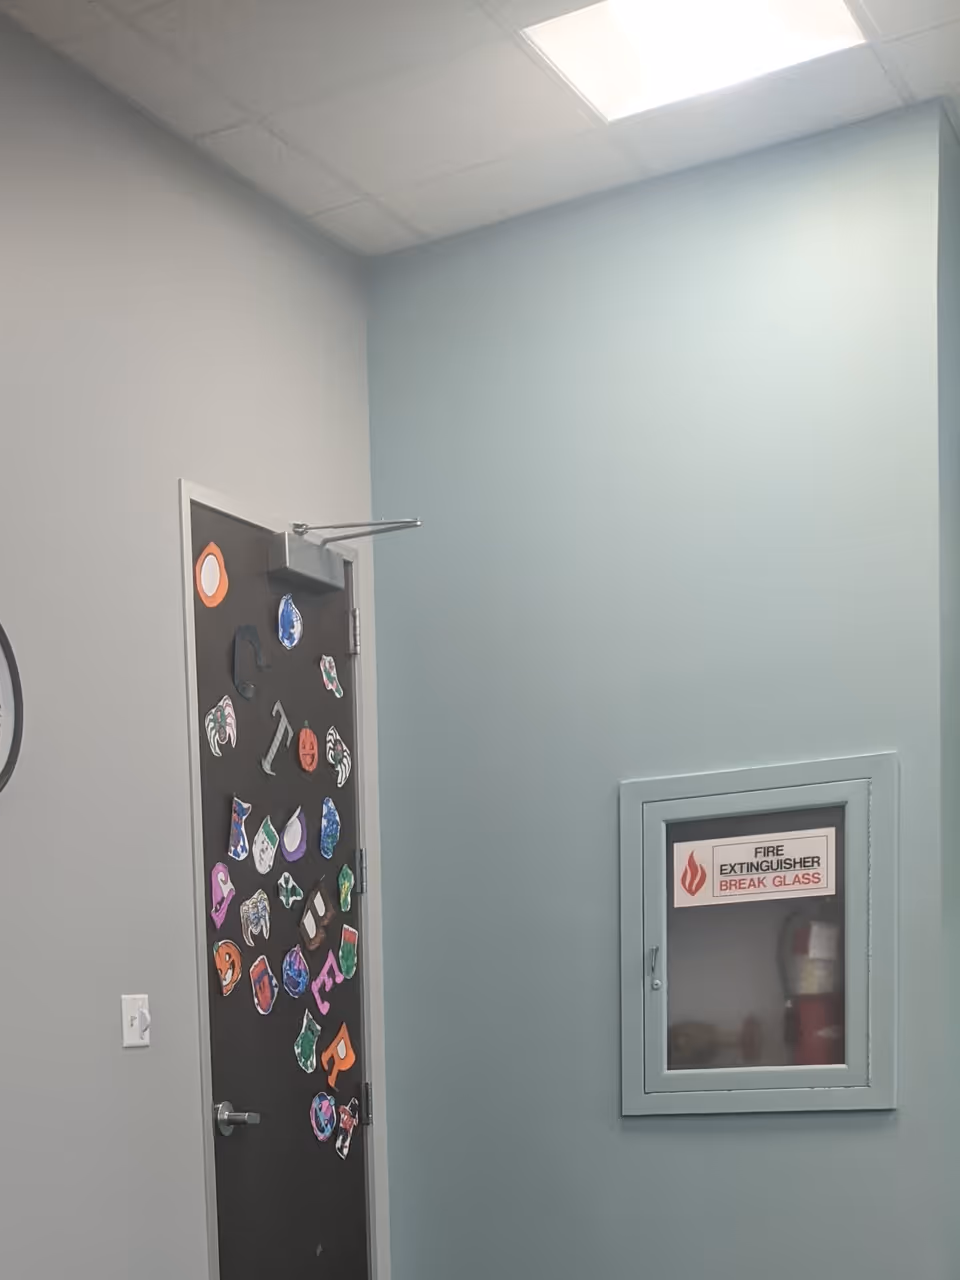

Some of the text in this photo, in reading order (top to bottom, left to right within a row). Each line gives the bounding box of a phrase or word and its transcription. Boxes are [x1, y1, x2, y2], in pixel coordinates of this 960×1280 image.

[754, 845, 784, 858] FIRE
[720, 856, 821, 875] EXTINGUISHER
[720, 872, 821, 891] BREAK GLASS
